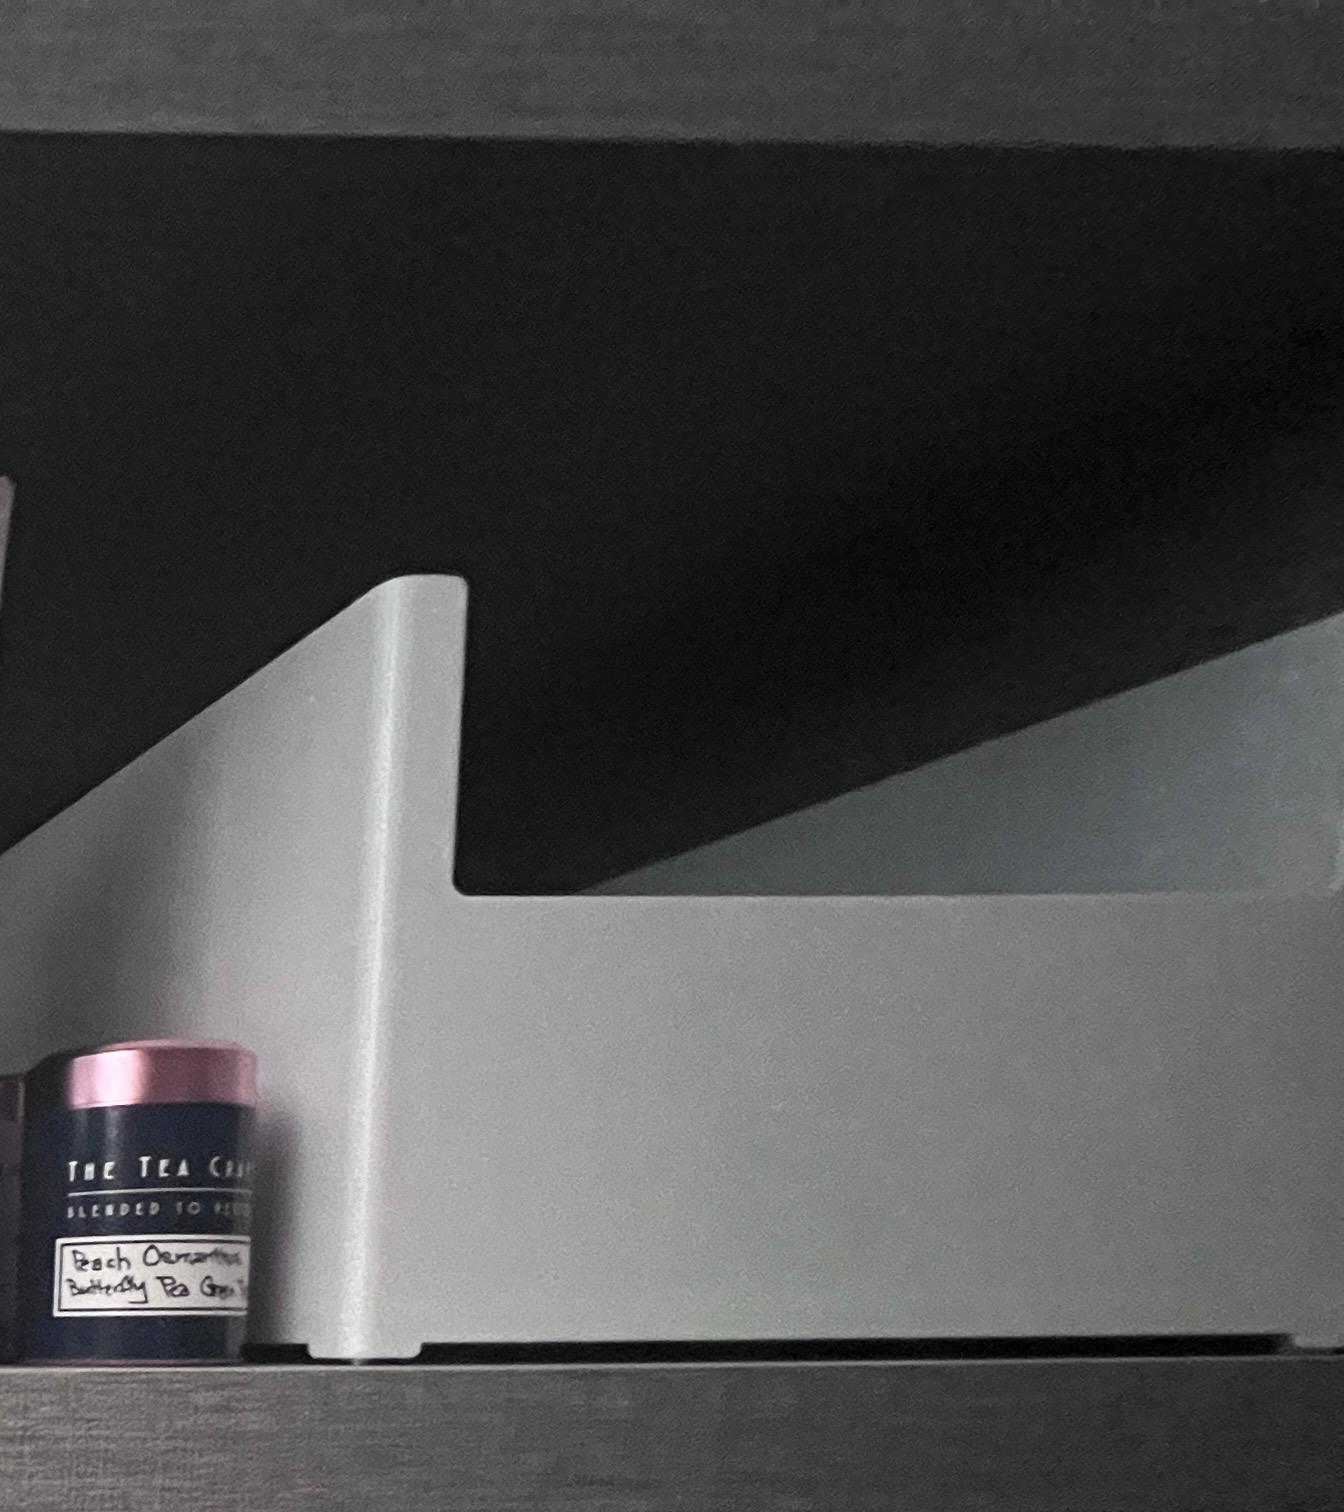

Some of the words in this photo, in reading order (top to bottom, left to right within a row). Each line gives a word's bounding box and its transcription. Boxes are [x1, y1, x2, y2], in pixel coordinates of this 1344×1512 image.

[68, 1161, 115, 1182] THE
[139, 1156, 190, 1178] TEA
[67, 1201, 160, 1218] BLENDED
